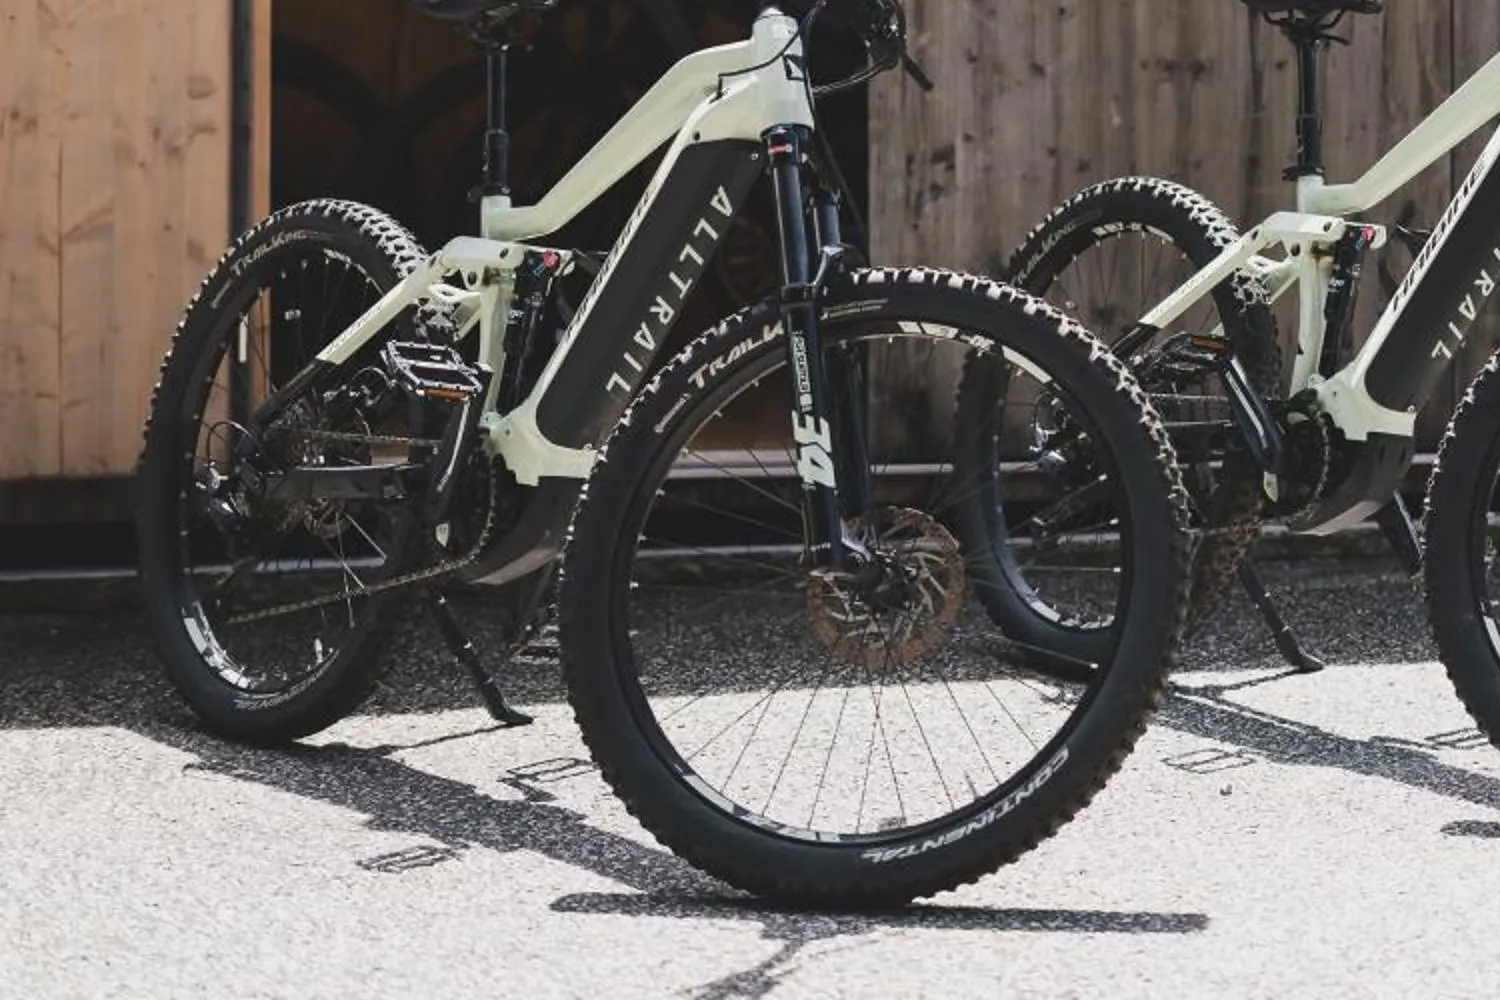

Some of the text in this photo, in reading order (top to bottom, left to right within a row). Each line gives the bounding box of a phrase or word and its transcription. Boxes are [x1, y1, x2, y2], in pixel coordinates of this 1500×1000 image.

[604, 184, 734, 393] ALLTRAIL
[791, 410, 836, 490] 34
[860, 746, 1070, 864] CONTINENTAL
